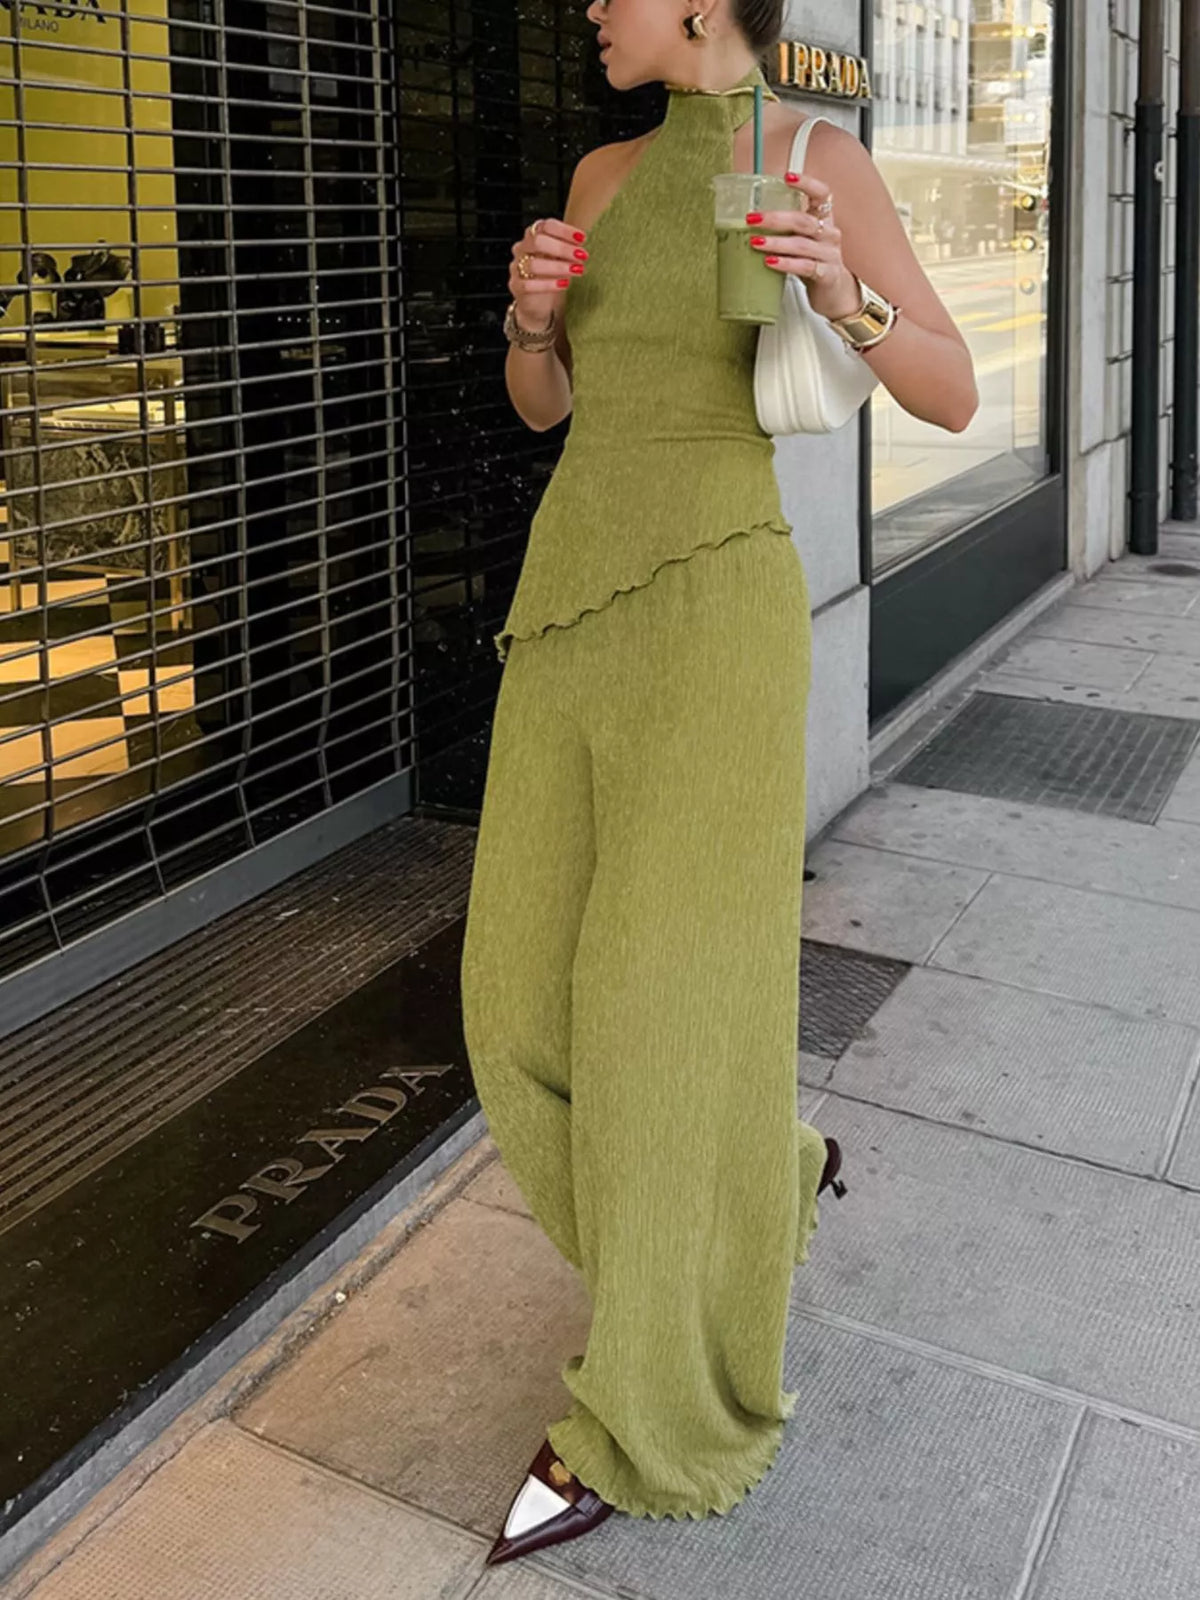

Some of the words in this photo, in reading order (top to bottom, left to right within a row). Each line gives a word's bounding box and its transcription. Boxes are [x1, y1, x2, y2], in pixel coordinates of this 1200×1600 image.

[0, 0, 106, 24] ADA
[788, 41, 872, 99] PRADA
[189, 1063, 454, 1244] PRADA
